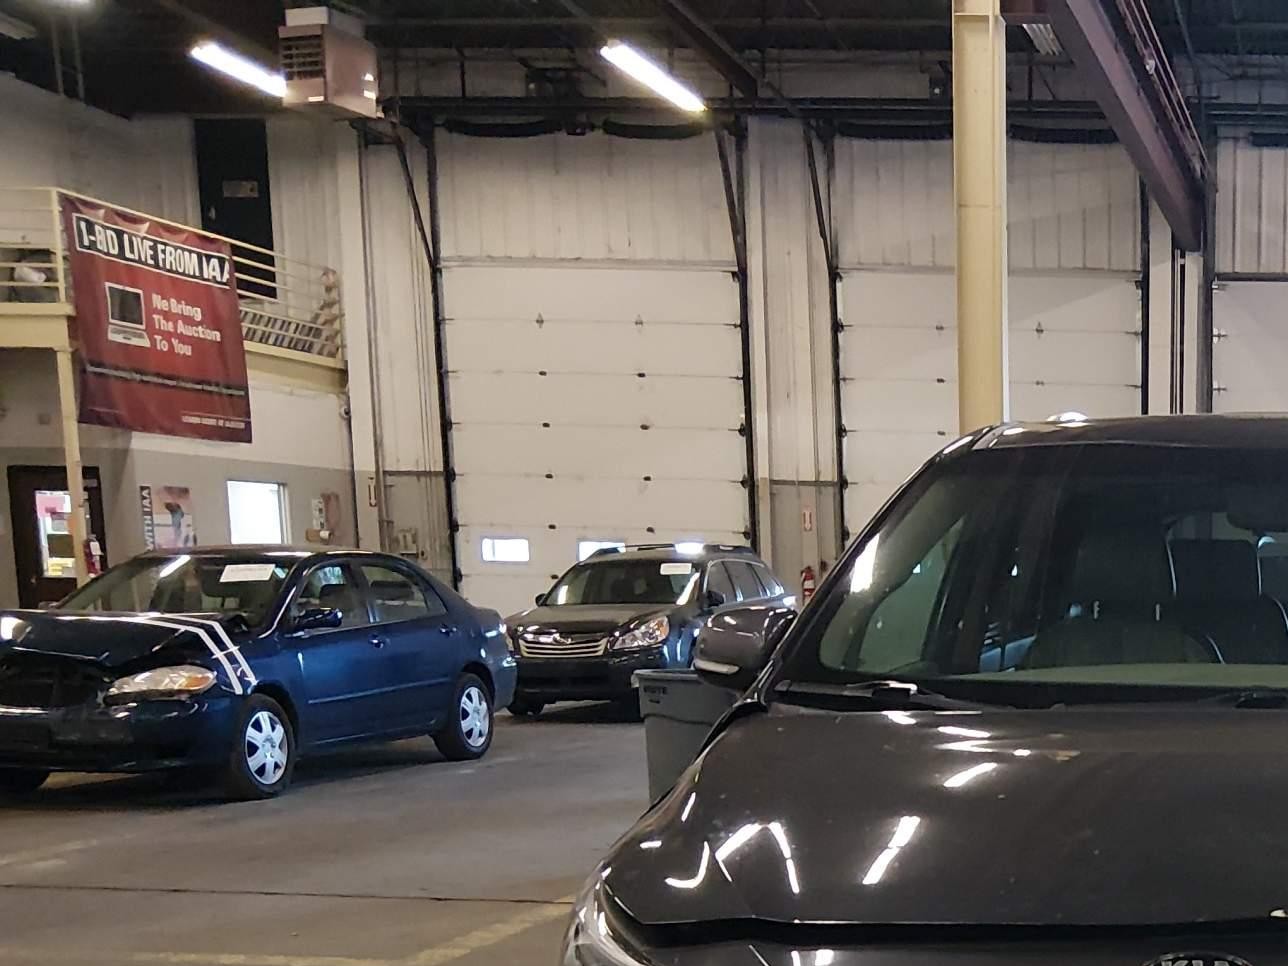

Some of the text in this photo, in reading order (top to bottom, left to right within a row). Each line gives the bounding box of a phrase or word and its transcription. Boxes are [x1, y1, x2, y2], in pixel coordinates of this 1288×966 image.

[123, 234, 155, 265] LIVE
[156, 244, 200, 277] FROM
[170, 297, 202, 321] Bring
[152, 314, 221, 342] The Auction
[153, 335, 192, 356] To You
